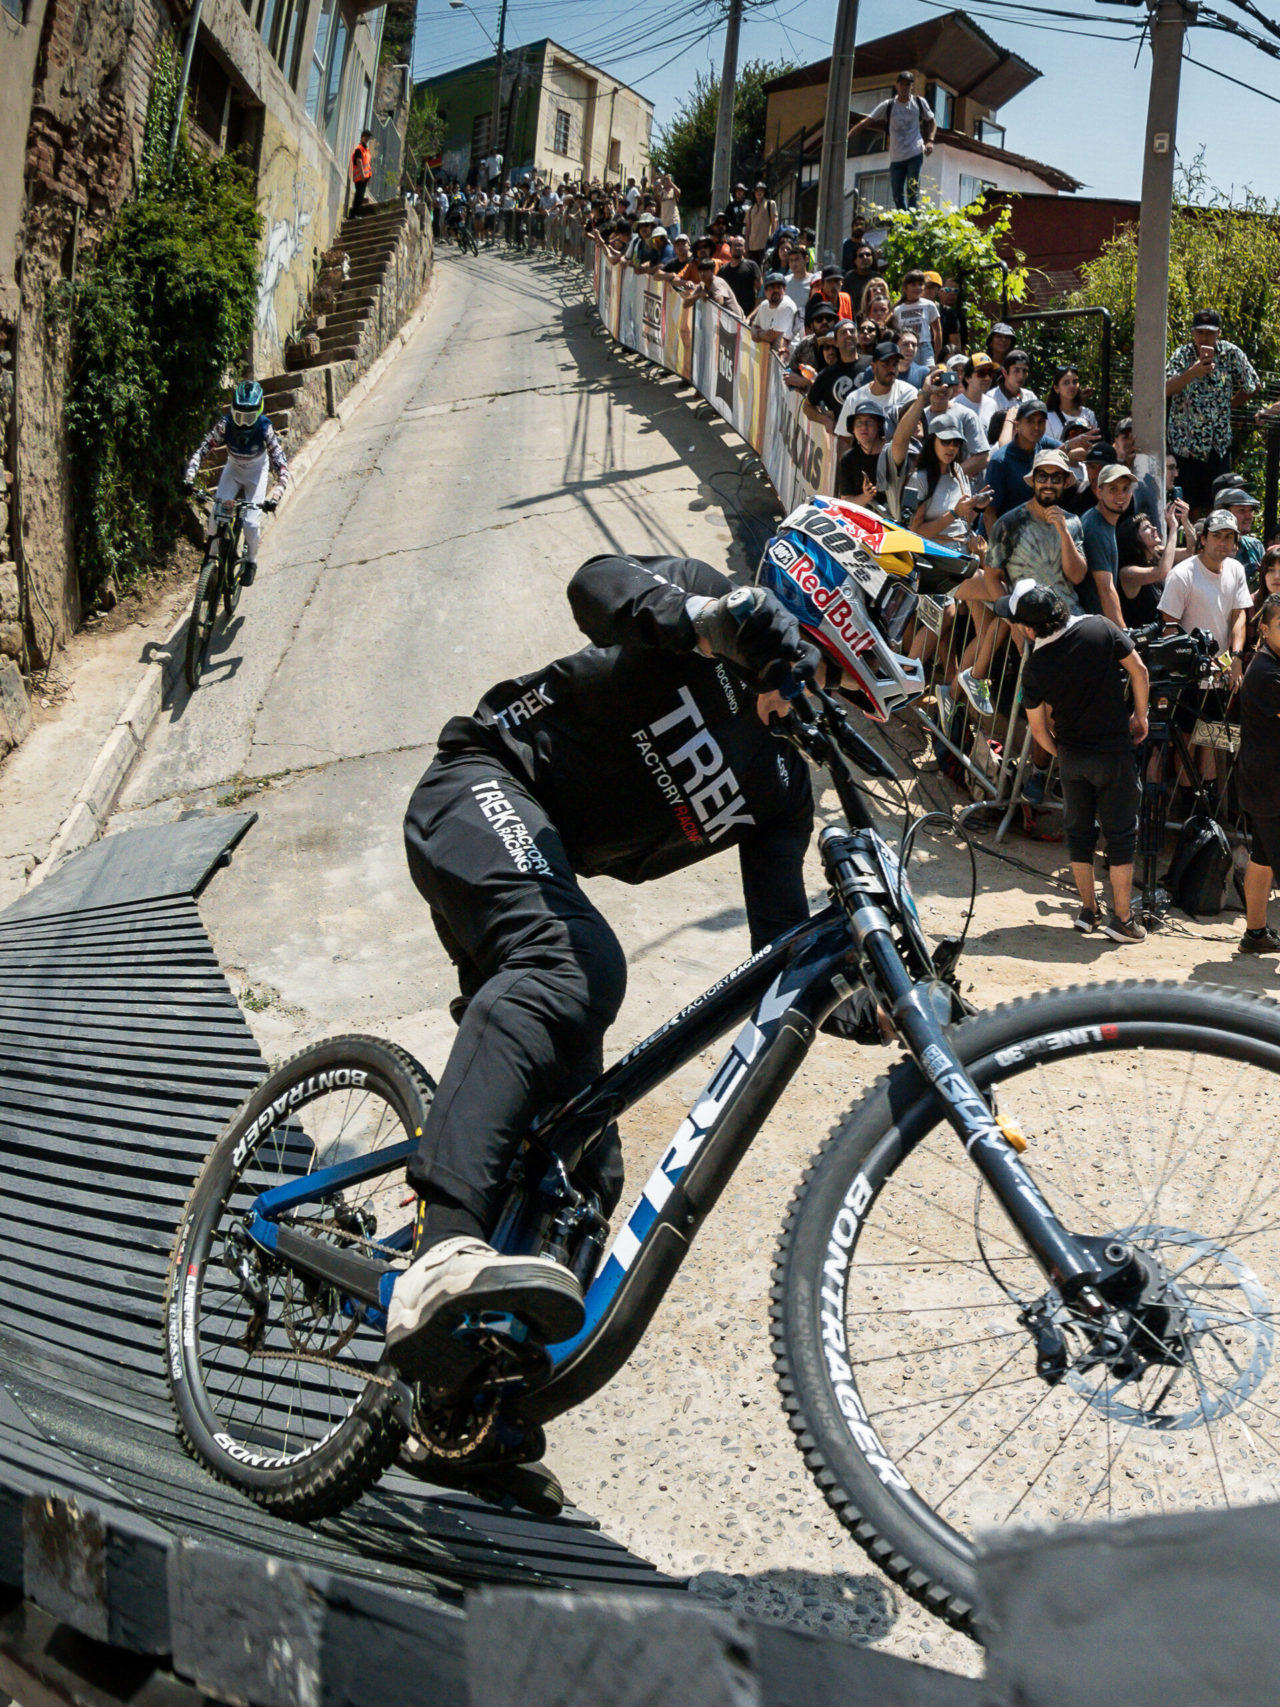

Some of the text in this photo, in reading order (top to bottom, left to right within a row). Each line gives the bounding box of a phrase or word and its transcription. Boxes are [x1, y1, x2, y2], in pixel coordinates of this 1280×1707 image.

[719, 345, 733, 382] ibis
[773, 543, 794, 564] 100%
[492, 682, 555, 729] TREK
[631, 729, 684, 806] FACTORY
[649, 685, 756, 844] TREK
[471, 780, 522, 830] TREK
[496, 827, 533, 872] RACING
[510, 823, 554, 877] FACTORY
[620, 943, 774, 1065] TREK FACTORY RACING
[232, 1069, 368, 1168] BONTRAGER
[595, 973, 799, 1279] TREK
[820, 1172, 911, 1491] BONTRAGER
